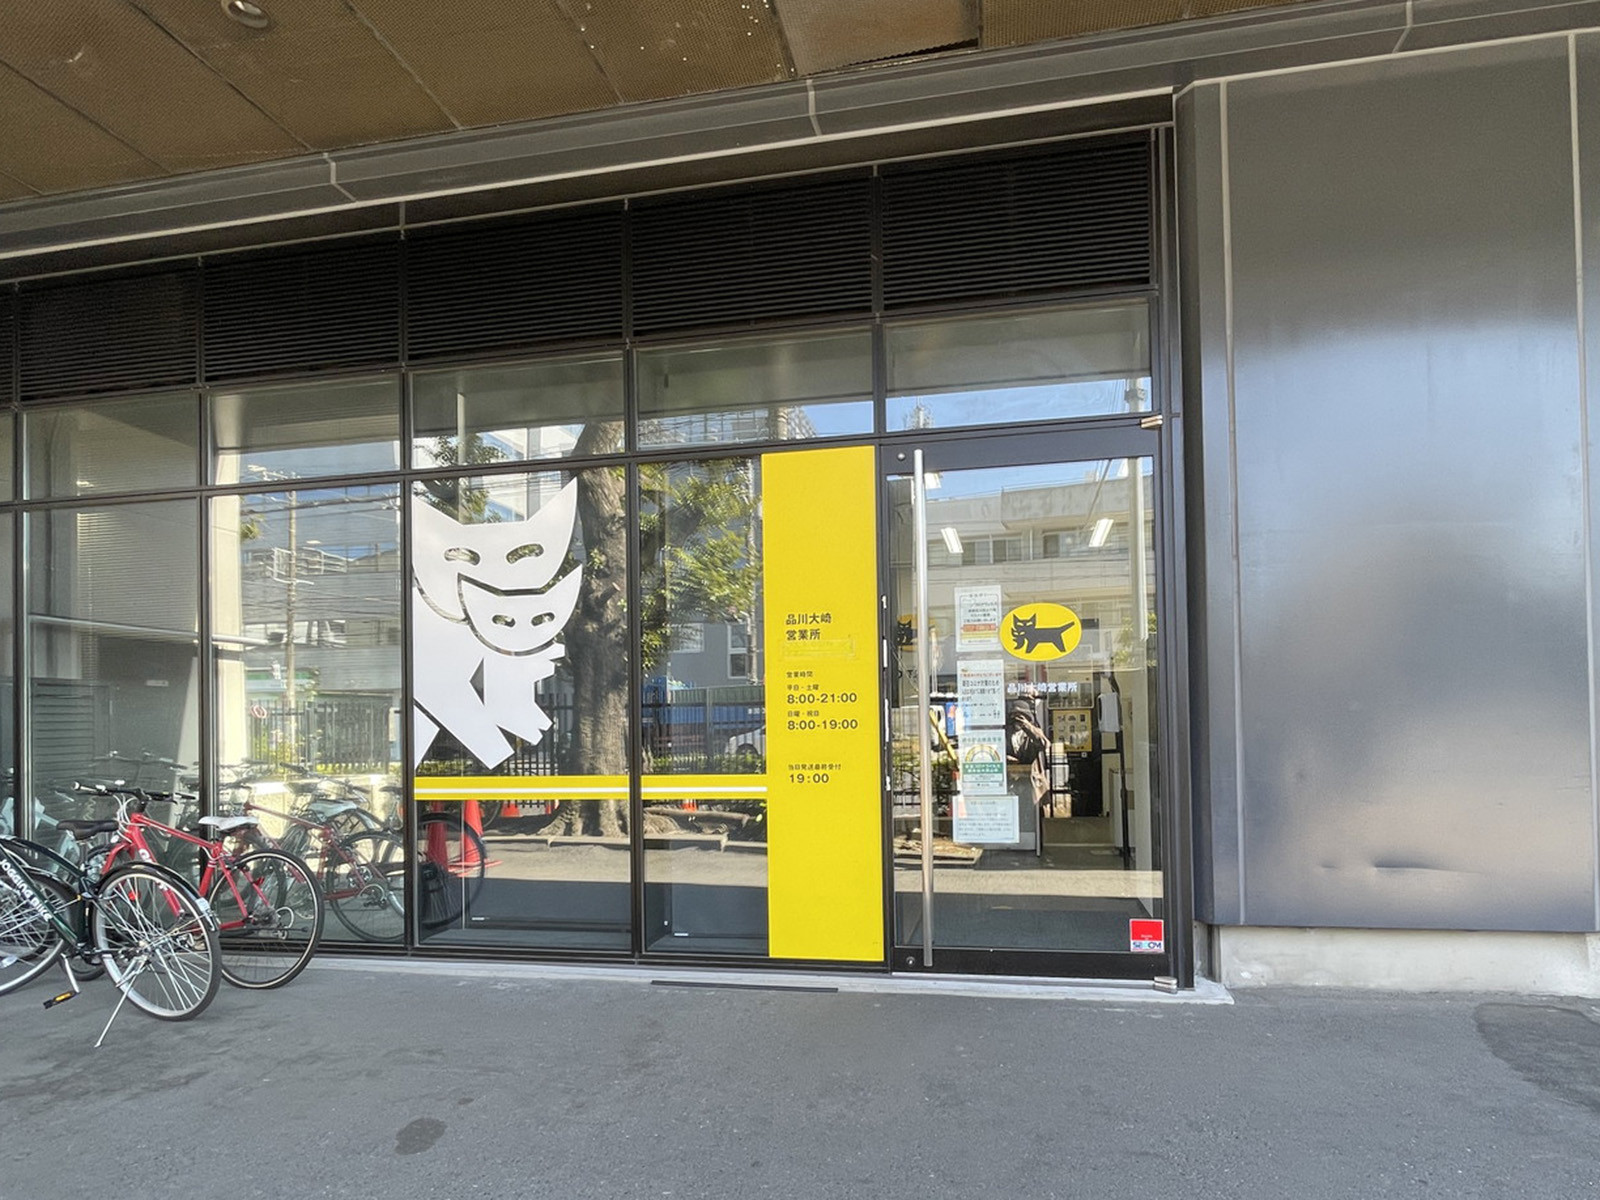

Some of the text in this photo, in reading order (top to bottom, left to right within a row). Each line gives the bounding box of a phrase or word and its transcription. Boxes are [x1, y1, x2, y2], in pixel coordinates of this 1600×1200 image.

[786, 612, 832, 625] 品川大崎
[786, 628, 821, 641] 営業所
[787, 692, 857, 704] 8:00-21:00
[787, 719, 858, 730] 8:00-19:00
[789, 773, 829, 783] 19:00
[31, 897, 52, 922] BIKE
